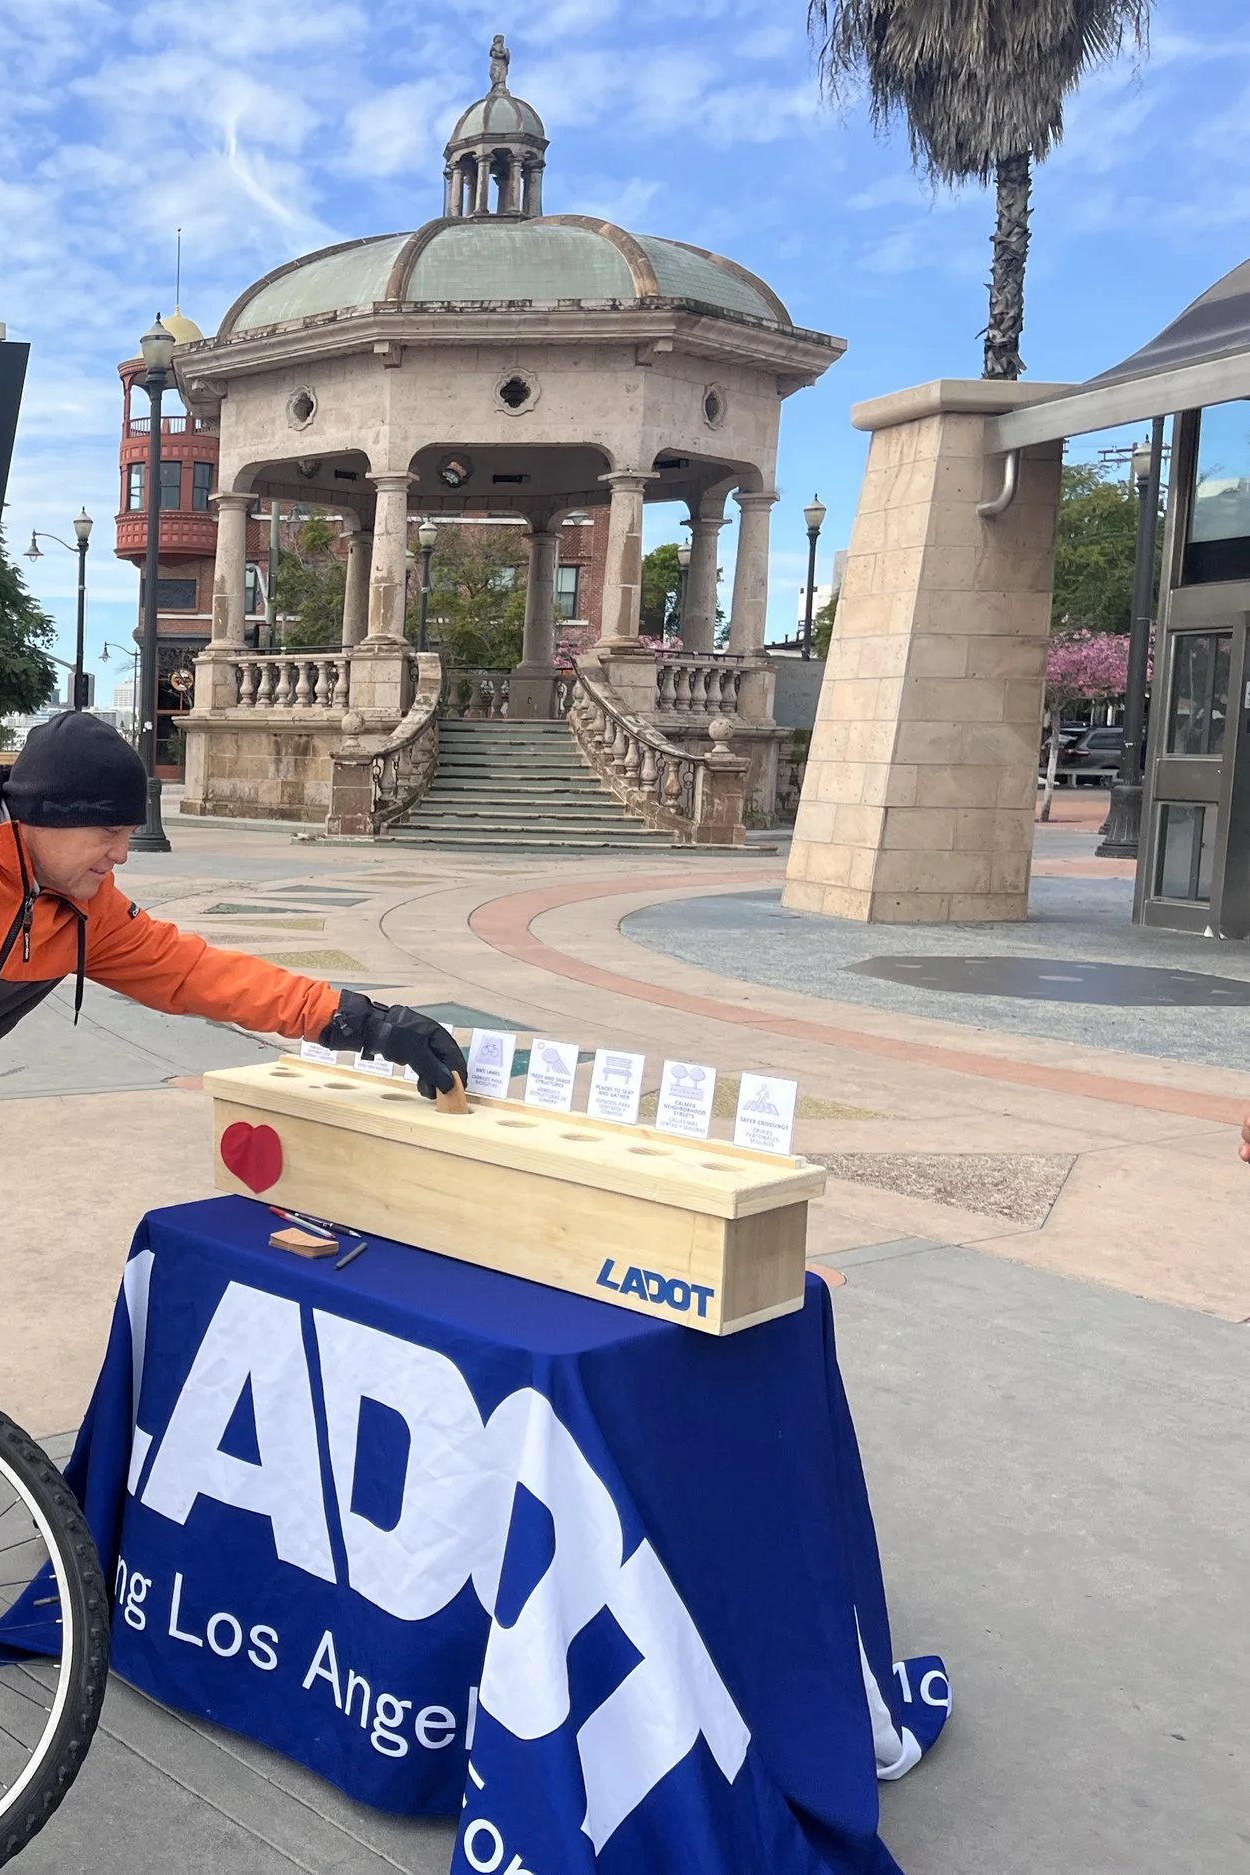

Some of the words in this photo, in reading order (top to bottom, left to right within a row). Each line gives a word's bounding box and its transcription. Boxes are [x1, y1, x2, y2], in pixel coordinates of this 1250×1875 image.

[595, 1257, 715, 1319] LADOT
[113, 1554, 152, 1632] ng
[168, 1571, 279, 1671] Los
[301, 1629, 479, 1758] Angel
